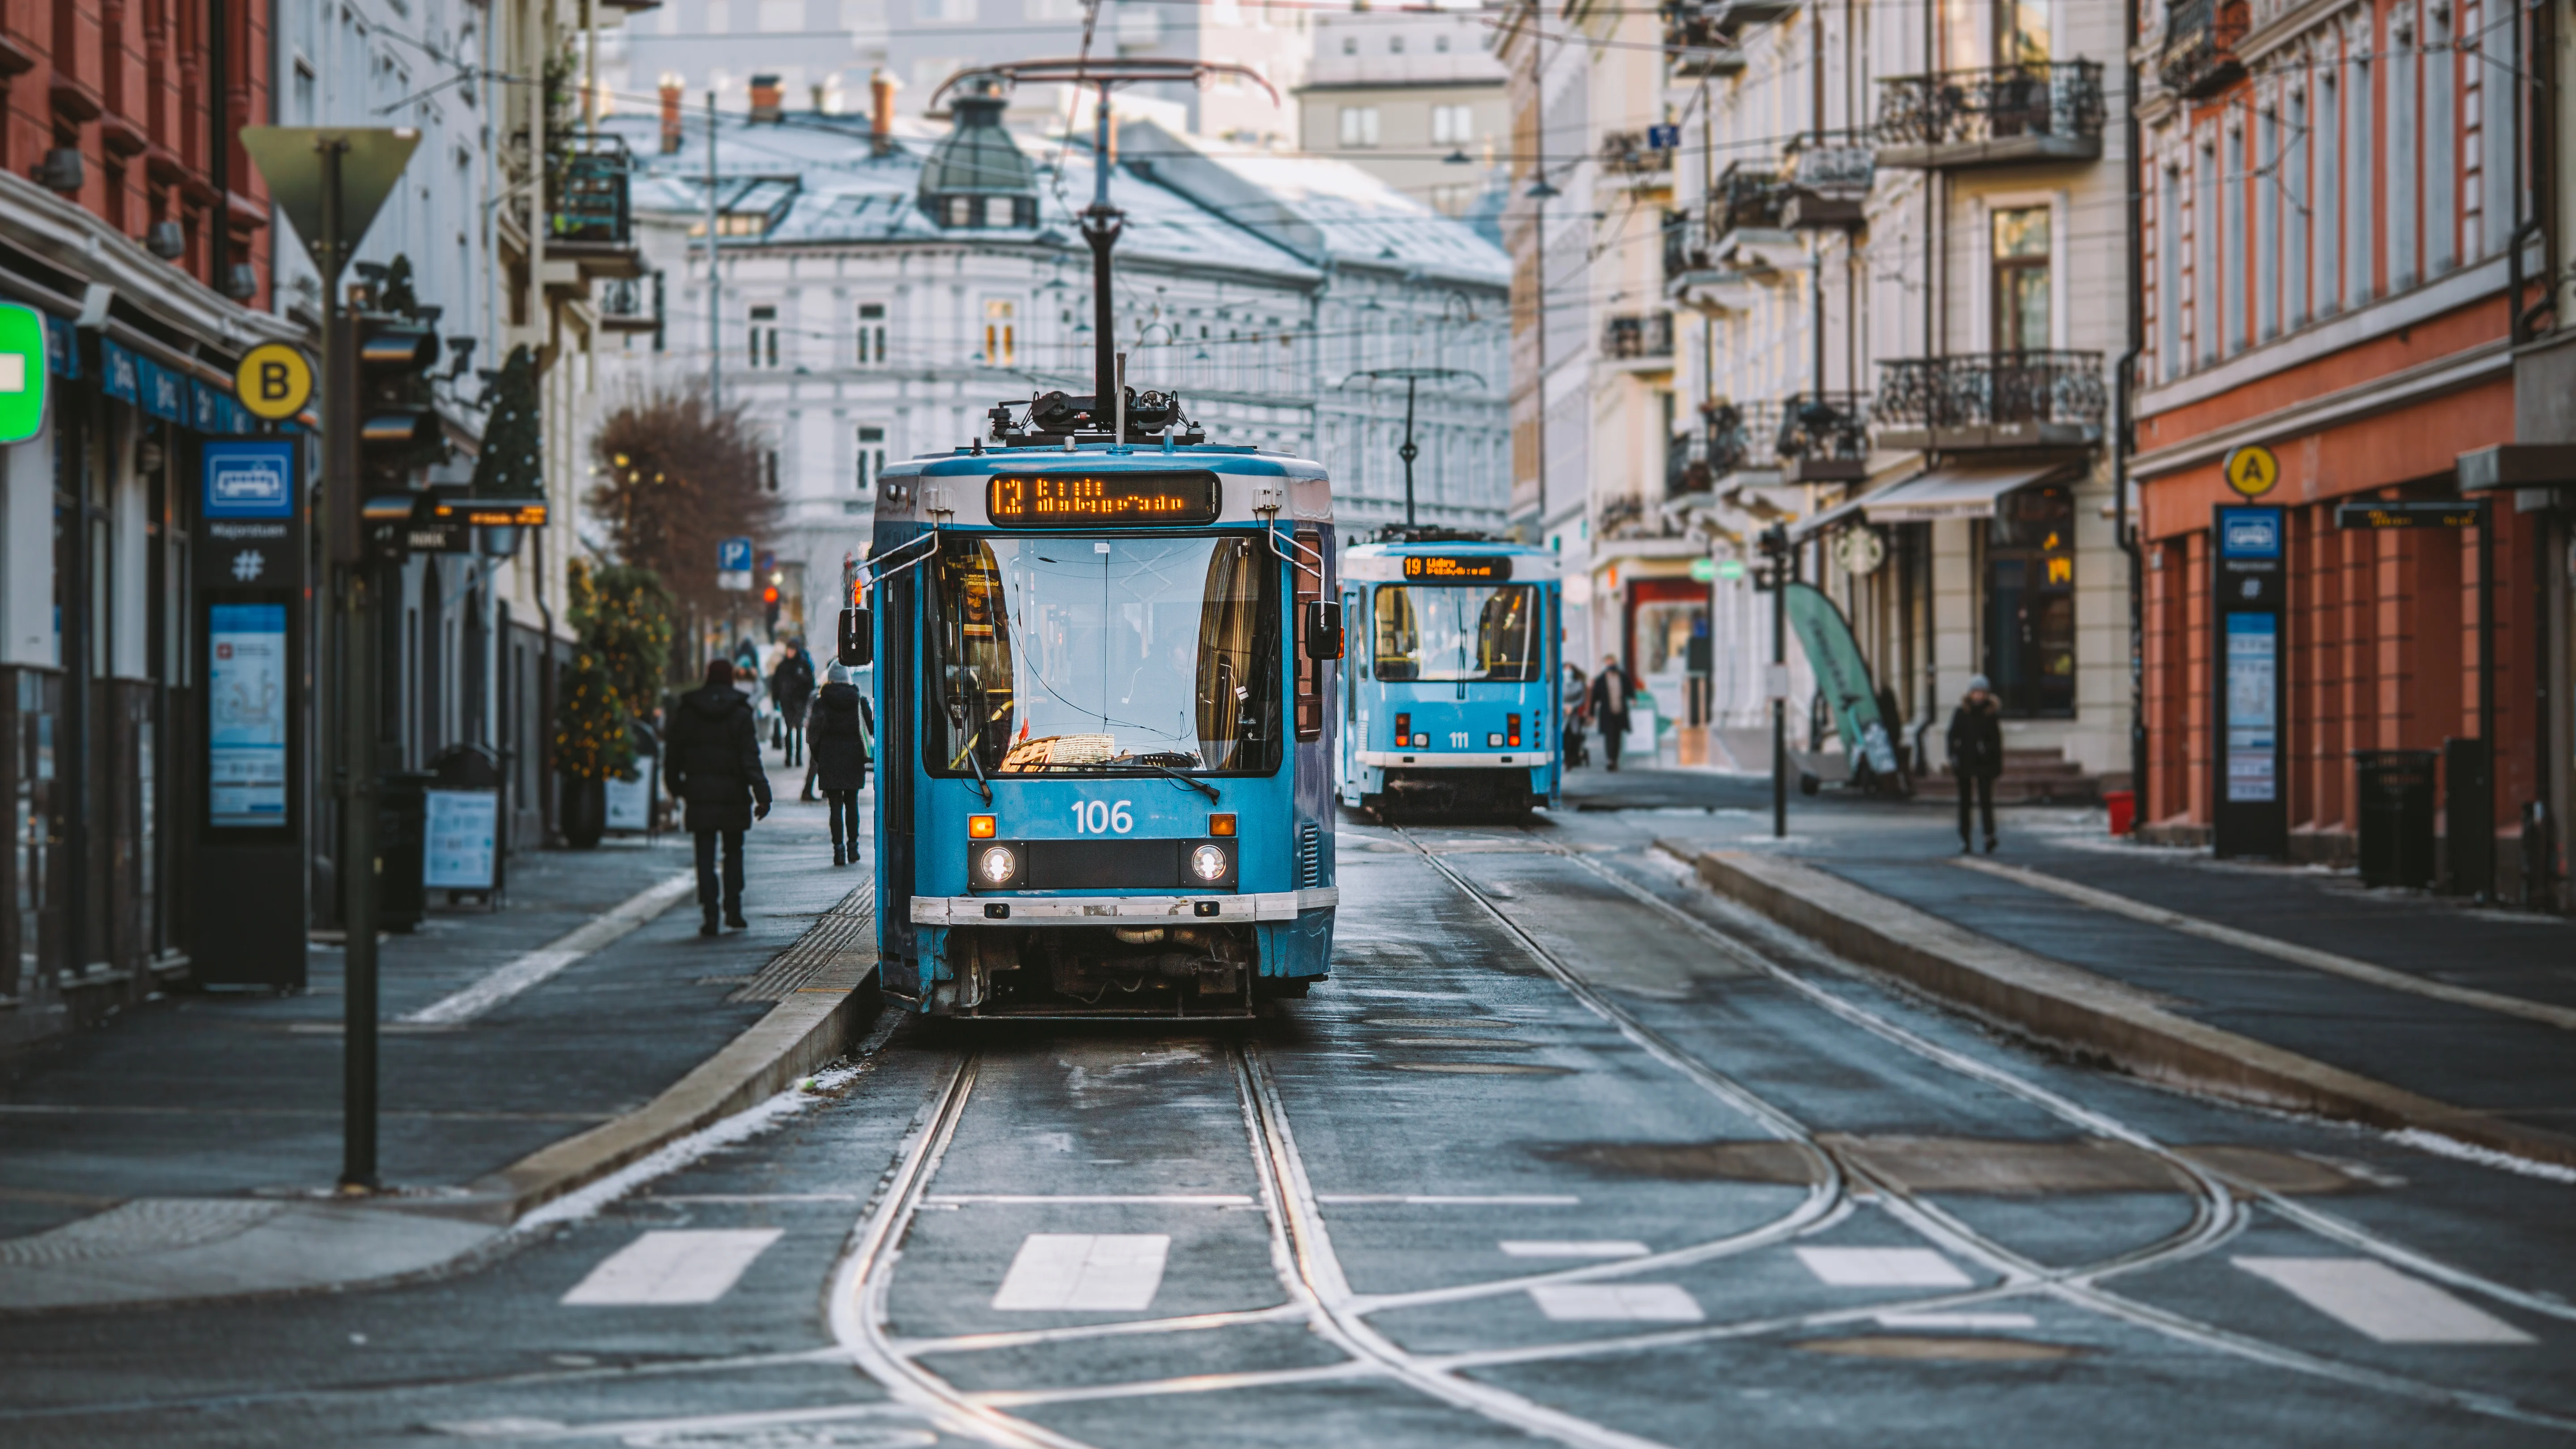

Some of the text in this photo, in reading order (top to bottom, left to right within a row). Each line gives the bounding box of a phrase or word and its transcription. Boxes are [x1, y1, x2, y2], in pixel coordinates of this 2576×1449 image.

[259, 361, 290, 401] B
[2241, 455, 2265, 483] A
[725, 542, 745, 567] P
[1405, 558, 1421, 575] 19
[1449, 731, 1469, 748] 111
[1071, 800, 1133, 834] 106
